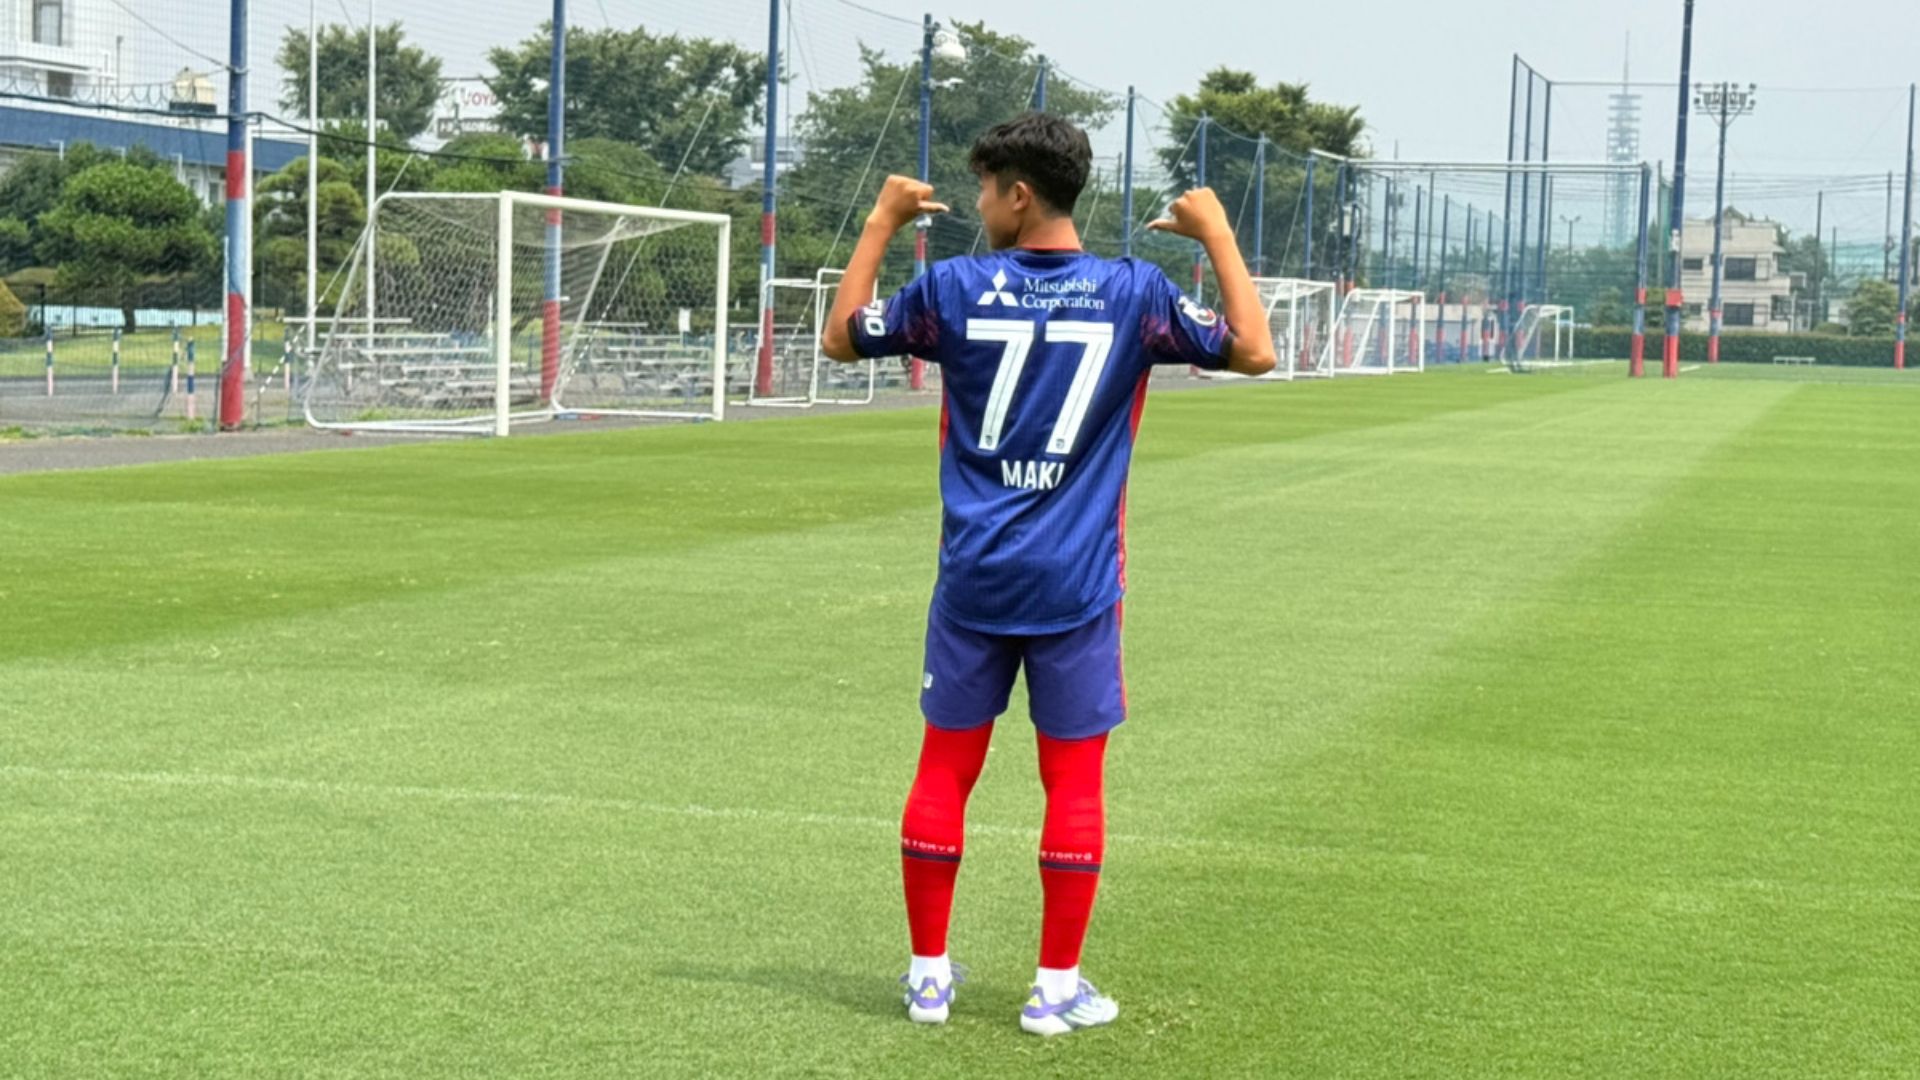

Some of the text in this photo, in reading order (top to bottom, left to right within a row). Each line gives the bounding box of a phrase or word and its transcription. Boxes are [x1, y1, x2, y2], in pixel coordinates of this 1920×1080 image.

[1023, 278, 1097, 294] Mitsubishi
[1022, 293, 1104, 312] Corporation
[966, 318, 1114, 454] 77
[1001, 459, 1065, 490] MAKI
